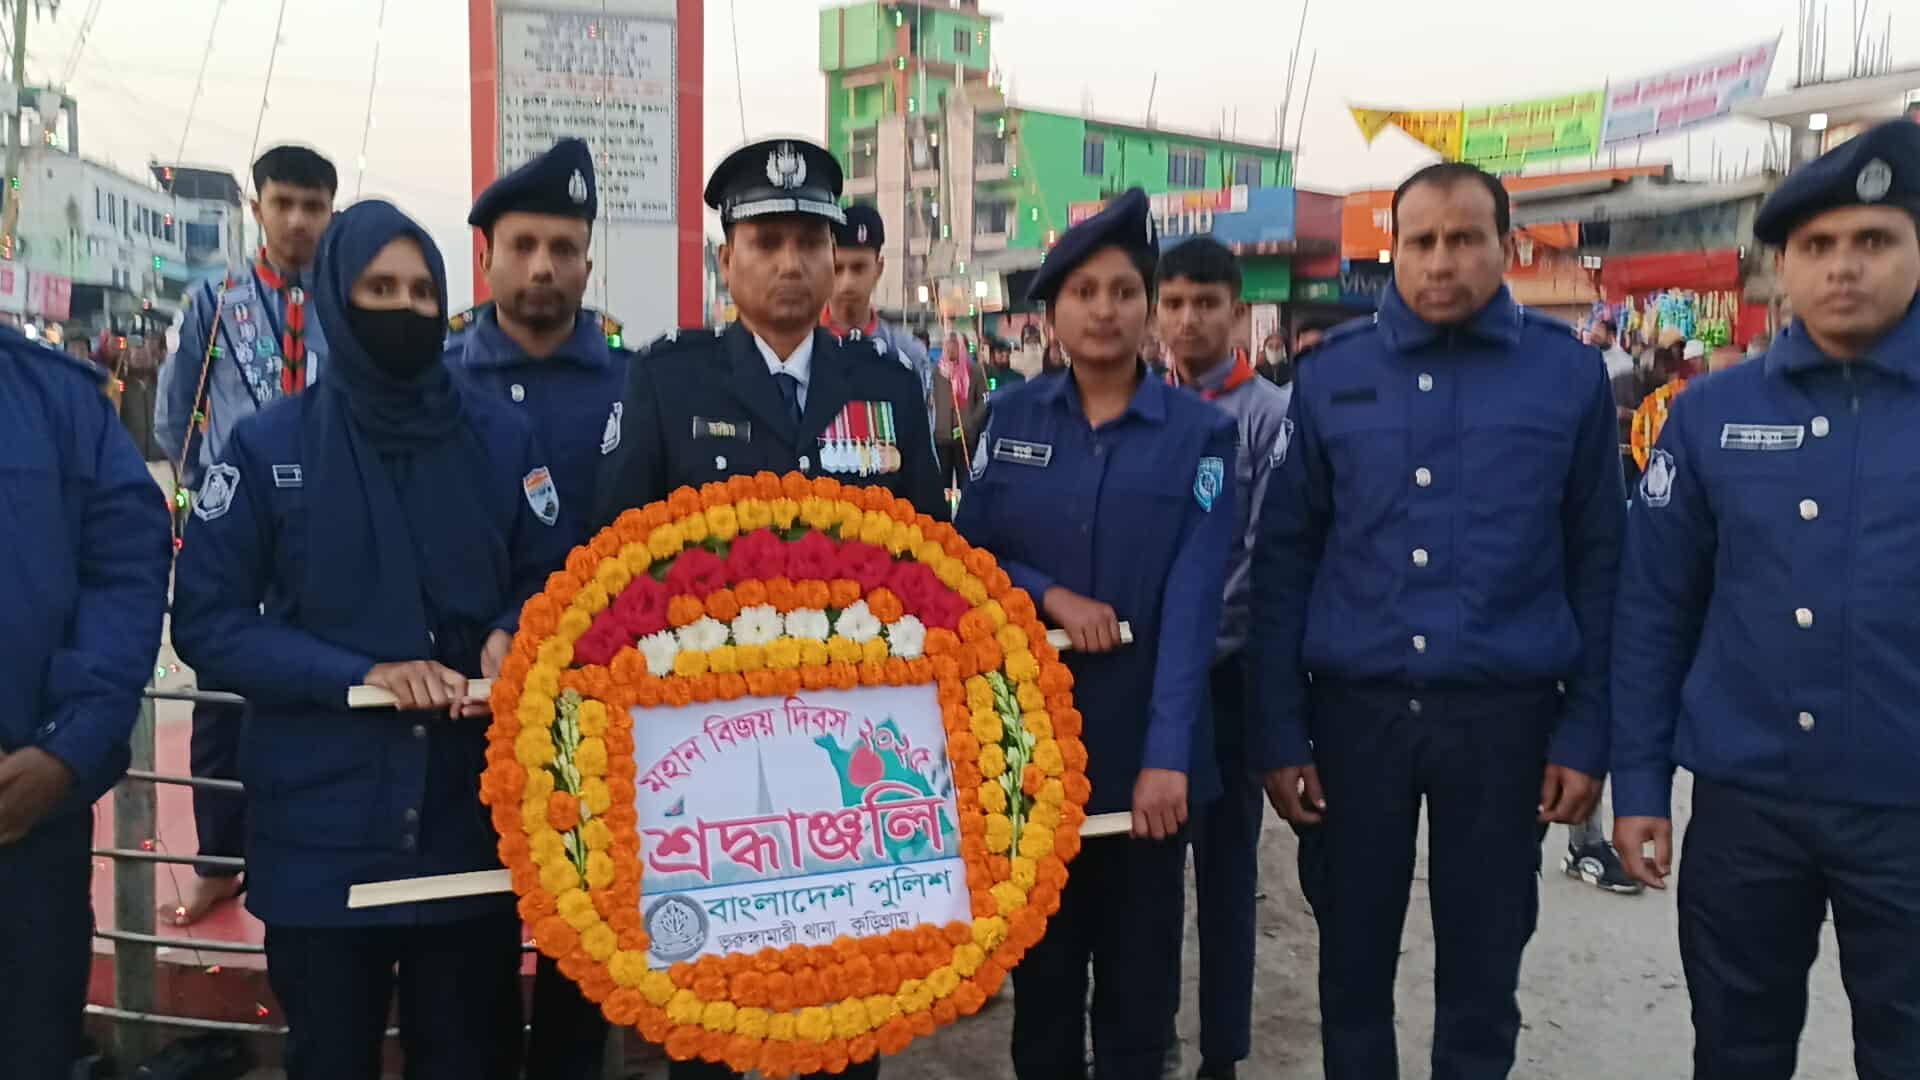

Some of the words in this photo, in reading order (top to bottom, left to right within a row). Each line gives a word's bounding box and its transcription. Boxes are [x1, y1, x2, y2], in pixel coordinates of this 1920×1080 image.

[637, 735, 706, 793] মহান
[703, 708, 777, 753] বিজয়
[783, 695, 851, 737] দিবস
[642, 780, 945, 881] শ্রদ্ধাঞ্জলি
[703, 881, 856, 924] বাংলাদেশ
[869, 866, 953, 909] পুলিশ
[802, 919, 837, 940] থানা
